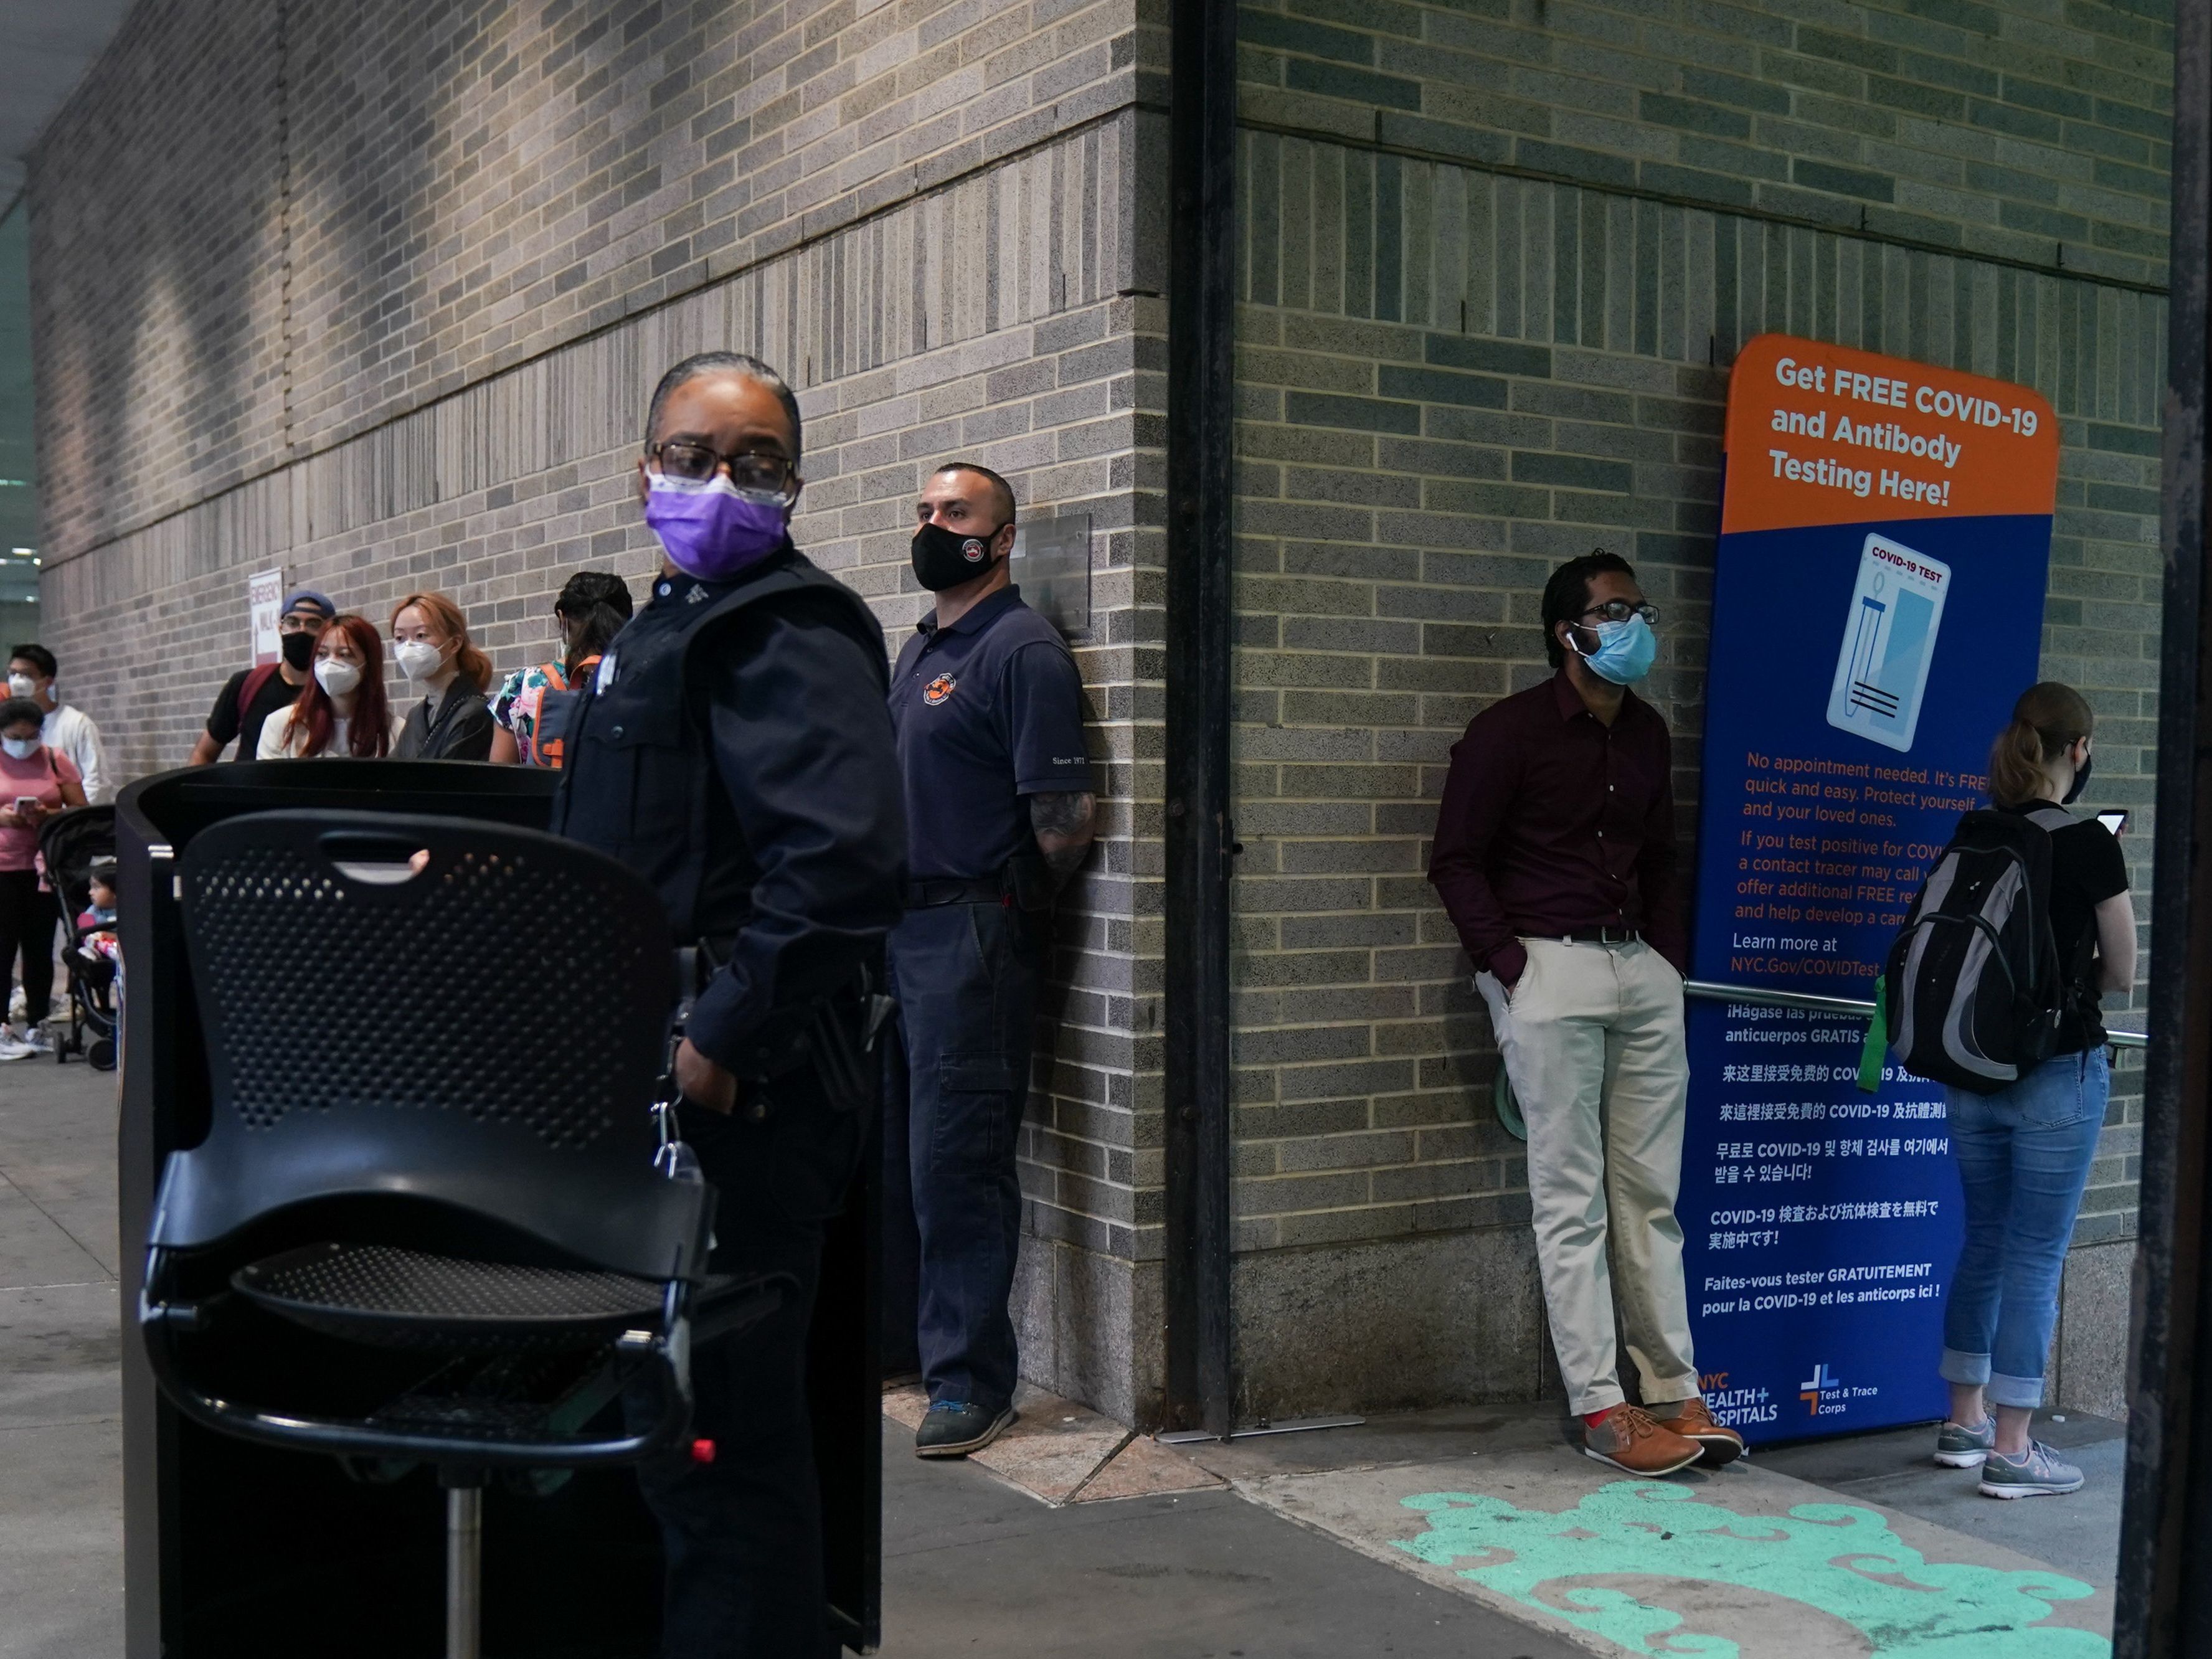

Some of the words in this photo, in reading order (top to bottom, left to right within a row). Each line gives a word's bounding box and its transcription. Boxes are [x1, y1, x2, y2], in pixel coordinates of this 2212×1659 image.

[1776, 357, 1826, 393] Get
[1833, 369, 1908, 409] FREE
[1915, 385, 2038, 437] COVID-19
[1771, 409, 1826, 439] and
[1833, 415, 1961, 468] Antibody
[1769, 449, 1871, 498] Testing
[1879, 468, 1950, 508] Here!
[1872, 547, 1917, 572] COVID-19
[1919, 565, 1942, 584] TEST
[1052, 757, 1072, 765] Since
[1747, 752, 1770, 768] No
[1774, 757, 1870, 778] appointment
[1874, 767, 1930, 785] needed.
[1745, 777, 1787, 795] quick
[1791, 782, 1820, 796] and
[1823, 786, 1859, 803] easy.
[1864, 787, 1916, 806] Protect
[1919, 795, 1976, 811] yourself
[1743, 801, 1772, 818] and
[1776, 805, 1811, 821] your
[1815, 805, 1856, 823] loved
[1860, 812, 1896, 827] ones.
[1741, 830, 1752, 846] If
[1756, 834, 1784, 850] you
[1789, 834, 1817, 851] test
[1821, 838, 1879, 856] positive
[1883, 840, 1903, 856] for
[1738, 858, 1748, 870] a
[1752, 857, 1810, 873] contact
[1815, 859, 1858, 877] tracer
[1861, 866, 1891, 882] may
[1895, 866, 1919, 881] call
[1737, 878, 1774, 896] offer
[1779, 881, 1853, 900] additional
[1857, 886, 1896, 902] FREE
[1734, 903, 1764, 919] and
[1768, 903, 1801, 923] help
[1805, 905, 1864, 927] develop
[1867, 912, 1876, 924] a
[1733, 932, 1775, 950] Learn
[1780, 937, 1818, 951] more
[1822, 937, 1837, 952] at
[1731, 956, 1880, 977] NYC.Gov/COVIDTest
[1725, 1028, 1807, 1045] anticuerpos
[1810, 1028, 1860, 1043] GRATIS
[1722, 1064, 1830, 1082] 来这里接受免费的
[1719, 1102, 1826, 1122] 來這裡接受免費的
[1829, 1104, 1890, 1118] COVID-19
[1716, 1142, 1754, 1161] 무료로
[1757, 1141, 1821, 1158] COVID-19
[1825, 1139, 1836, 1157] 및
[1840, 1138, 1863, 1157] 항체
[1866, 1138, 1901, 1156] 검사를
[1904, 1137, 1949, 1156] 여기에서
[1714, 1165, 1739, 1184] 받을
[1743, 1165, 1756, 1183] 수
[1759, 1163, 1812, 1182] 있습니다!
[1711, 1208, 1775, 1226] COVID-19
[1779, 1199, 1939, 1224] 検査および抗体検査を無料で
[1708, 1229, 1779, 1250] 実施中です!
[1704, 1275, 1782, 1292] Faites-vous
[1785, 1270, 1825, 1285] tester
[1828, 1262, 1932, 1282] GRATUITEMENT
[1702, 1301, 1736, 1318] pour
[1738, 1297, 1751, 1312] la
[1754, 1292, 1817, 1310] COVID-19
[1820, 1292, 1833, 1305] et
[1836, 1290, 1855, 1304] les
[1857, 1287, 1916, 1302] anticorps
[1918, 1283, 1933, 1298] ici
[1698, 1372, 1729, 1391] NYC
[1820, 1389, 1841, 1401] Test
[1842, 1387, 1850, 1398] &
[1852, 1386, 1878, 1397] Trace
[1818, 1404, 1846, 1415] Corps
